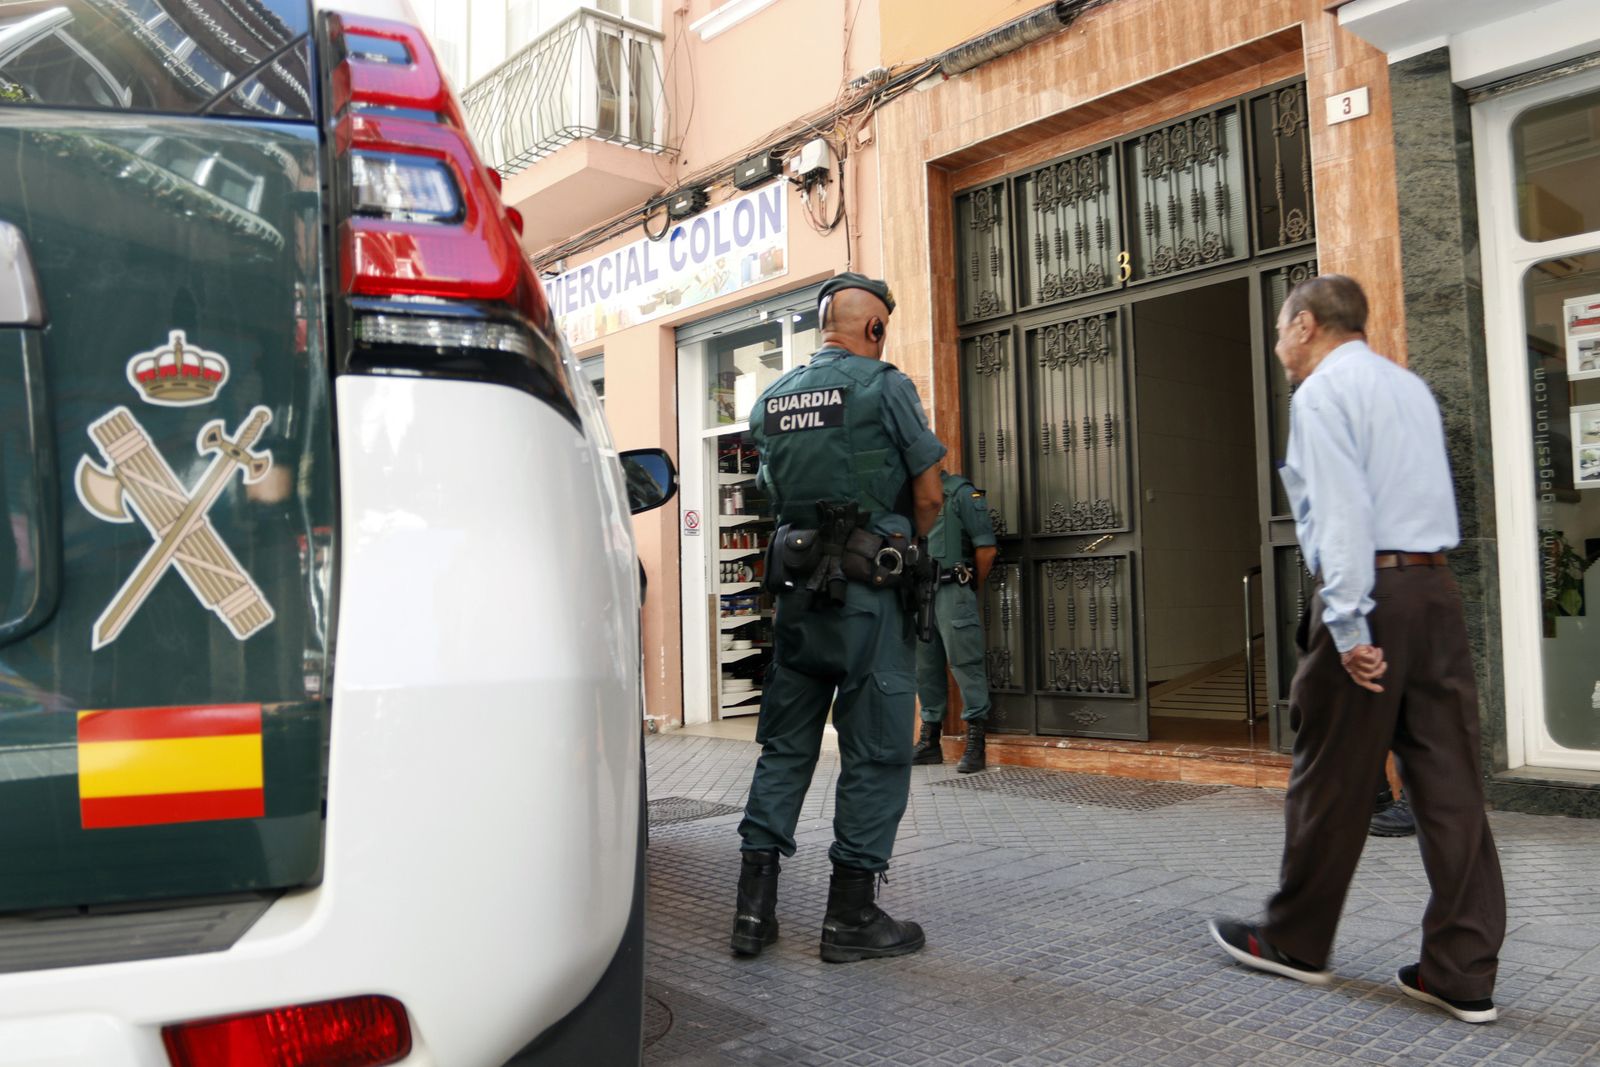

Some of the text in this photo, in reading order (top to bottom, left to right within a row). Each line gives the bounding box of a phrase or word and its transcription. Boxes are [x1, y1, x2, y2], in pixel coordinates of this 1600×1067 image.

[1342, 96, 1352, 115] 3
[669, 185, 782, 272] COLON
[1117, 251, 1132, 282] 3
[767, 389, 842, 414] GUARDIA
[780, 411, 825, 431] CIVIL
